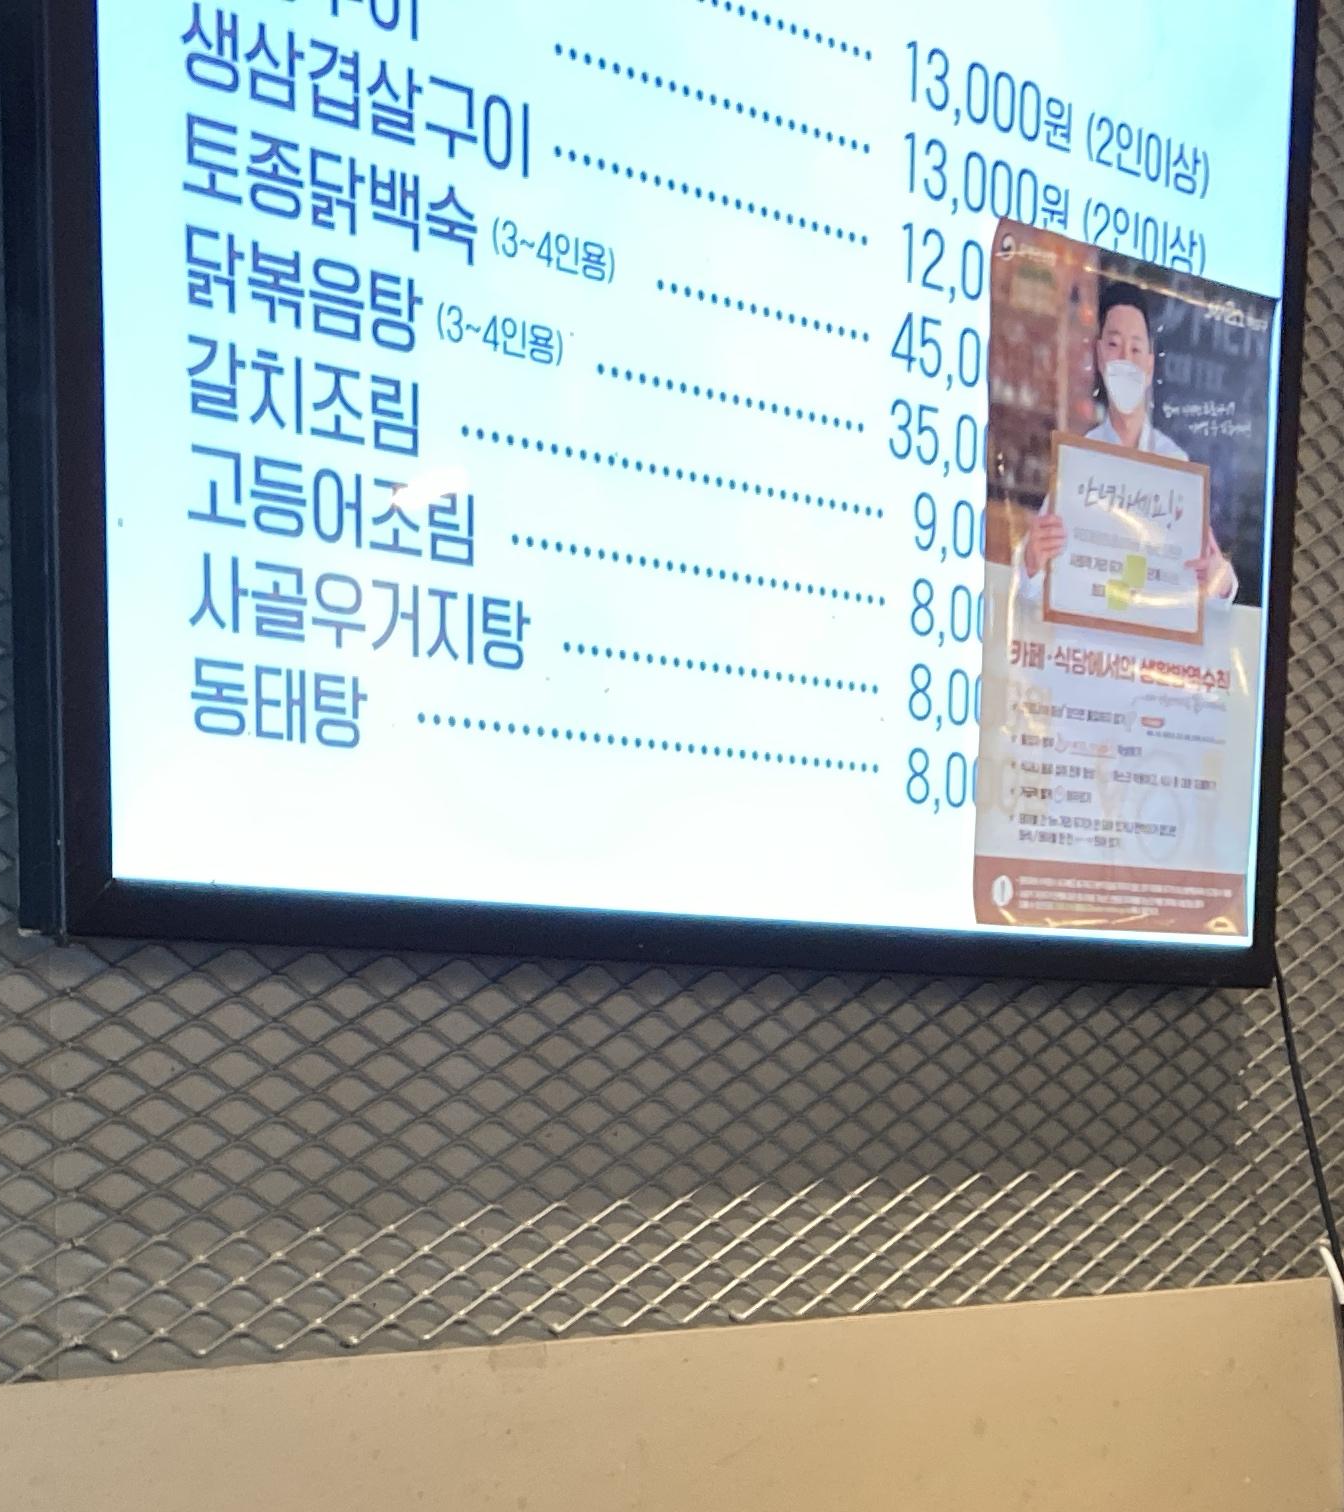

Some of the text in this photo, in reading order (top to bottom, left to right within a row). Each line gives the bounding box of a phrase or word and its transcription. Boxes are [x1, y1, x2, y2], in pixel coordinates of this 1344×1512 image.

[180, 1, 983, 303] 생삼겹살구이 12,0
[904, 132, 1070, 230] 13,000원
[906, 41, 1210, 200] 13,000원 (2인이상)
[180, 112, 981, 391] 토종닭백숙 (3~4인용) 45,0
[184, 223, 988, 478] 닭볶음탕 (3~4인용) 35,0
[185, 333, 987, 562] 갈치조림 9,0
[187, 444, 984, 647] 고등어조림 8,0
[188, 551, 532, 671] 사골우거지탕
[189, 656, 368, 749] 동태탕
[906, 747, 979, 814] 8,0
